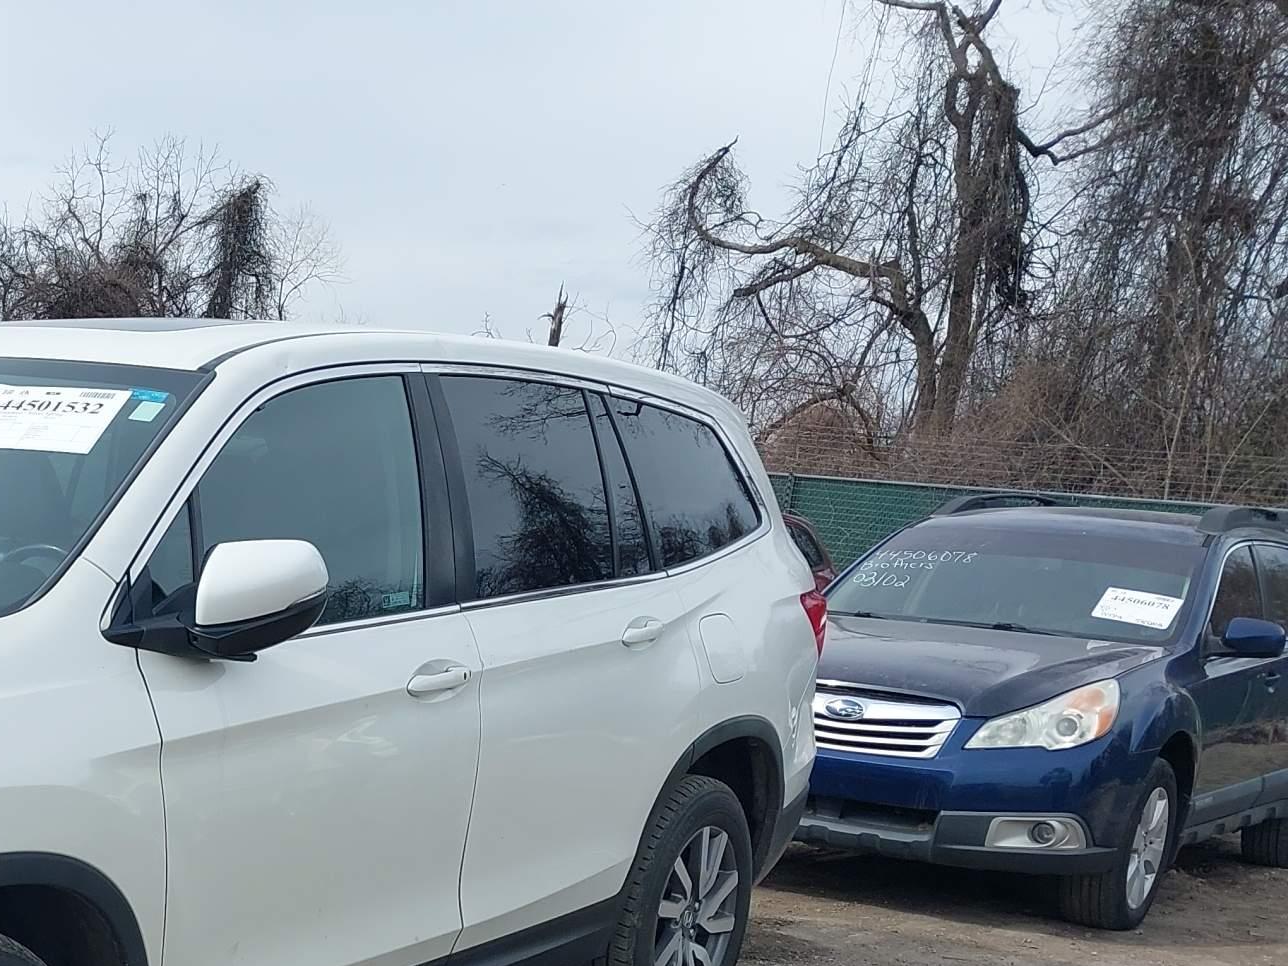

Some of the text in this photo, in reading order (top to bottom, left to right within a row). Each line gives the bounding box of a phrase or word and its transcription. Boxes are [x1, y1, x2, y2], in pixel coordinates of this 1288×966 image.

[876, 550, 978, 564] 44506078
[853, 571, 911, 588] 03/02
[1110, 595, 1171, 610] 44506078
